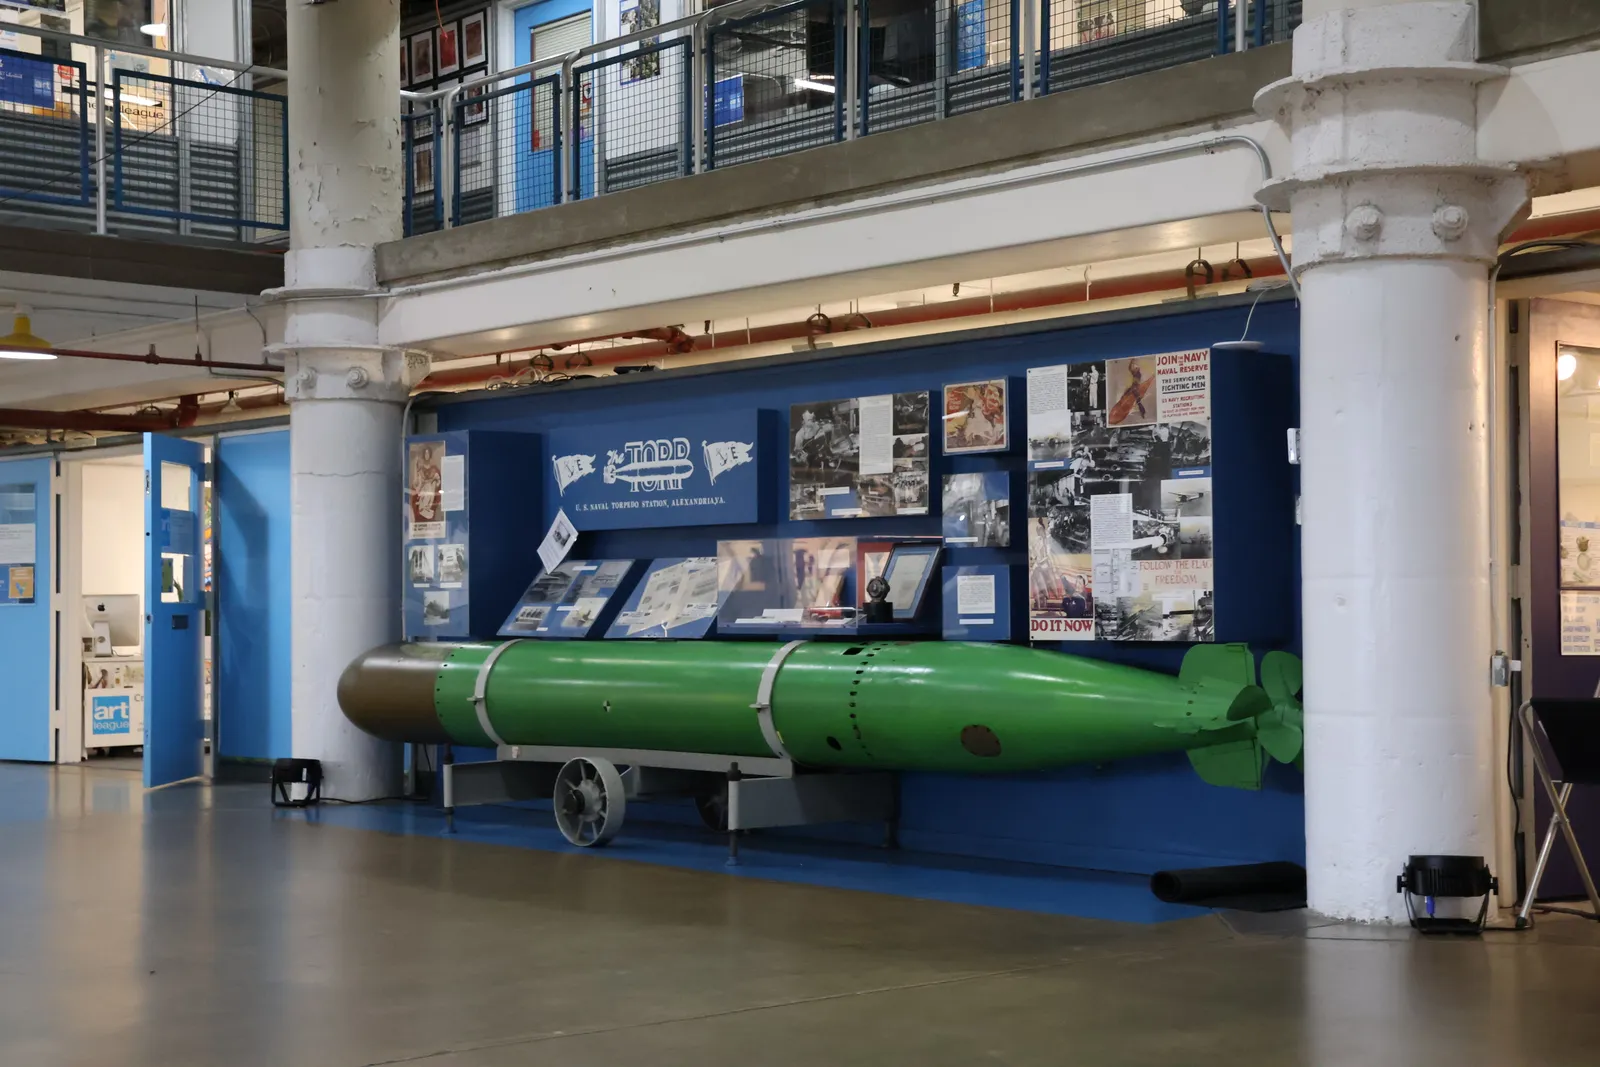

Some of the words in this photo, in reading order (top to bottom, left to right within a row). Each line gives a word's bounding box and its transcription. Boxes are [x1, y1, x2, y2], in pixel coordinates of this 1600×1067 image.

[121, 105, 164, 119] league
[1157, 356, 1177, 366] JOIN
[1184, 351, 1208, 361] NAVY
[1180, 364, 1208, 372] RESERVE
[1161, 382, 1190, 391] FIGHTING
[590, 502, 609, 511] NAVAL
[611, 501, 639, 509] TORPEDO
[641, 499, 669, 508] STATION,
[1139, 560, 1172, 570] FOLLOW
[1175, 560, 1189, 569] THE
[1155, 574, 1198, 585] FREEDOM
[1030, 619, 1049, 631] DO
[1049, 619, 1062, 631] IT
[1063, 619, 1093, 632] NOW
[94, 702, 129, 720] art
[93, 720, 129, 731] league
